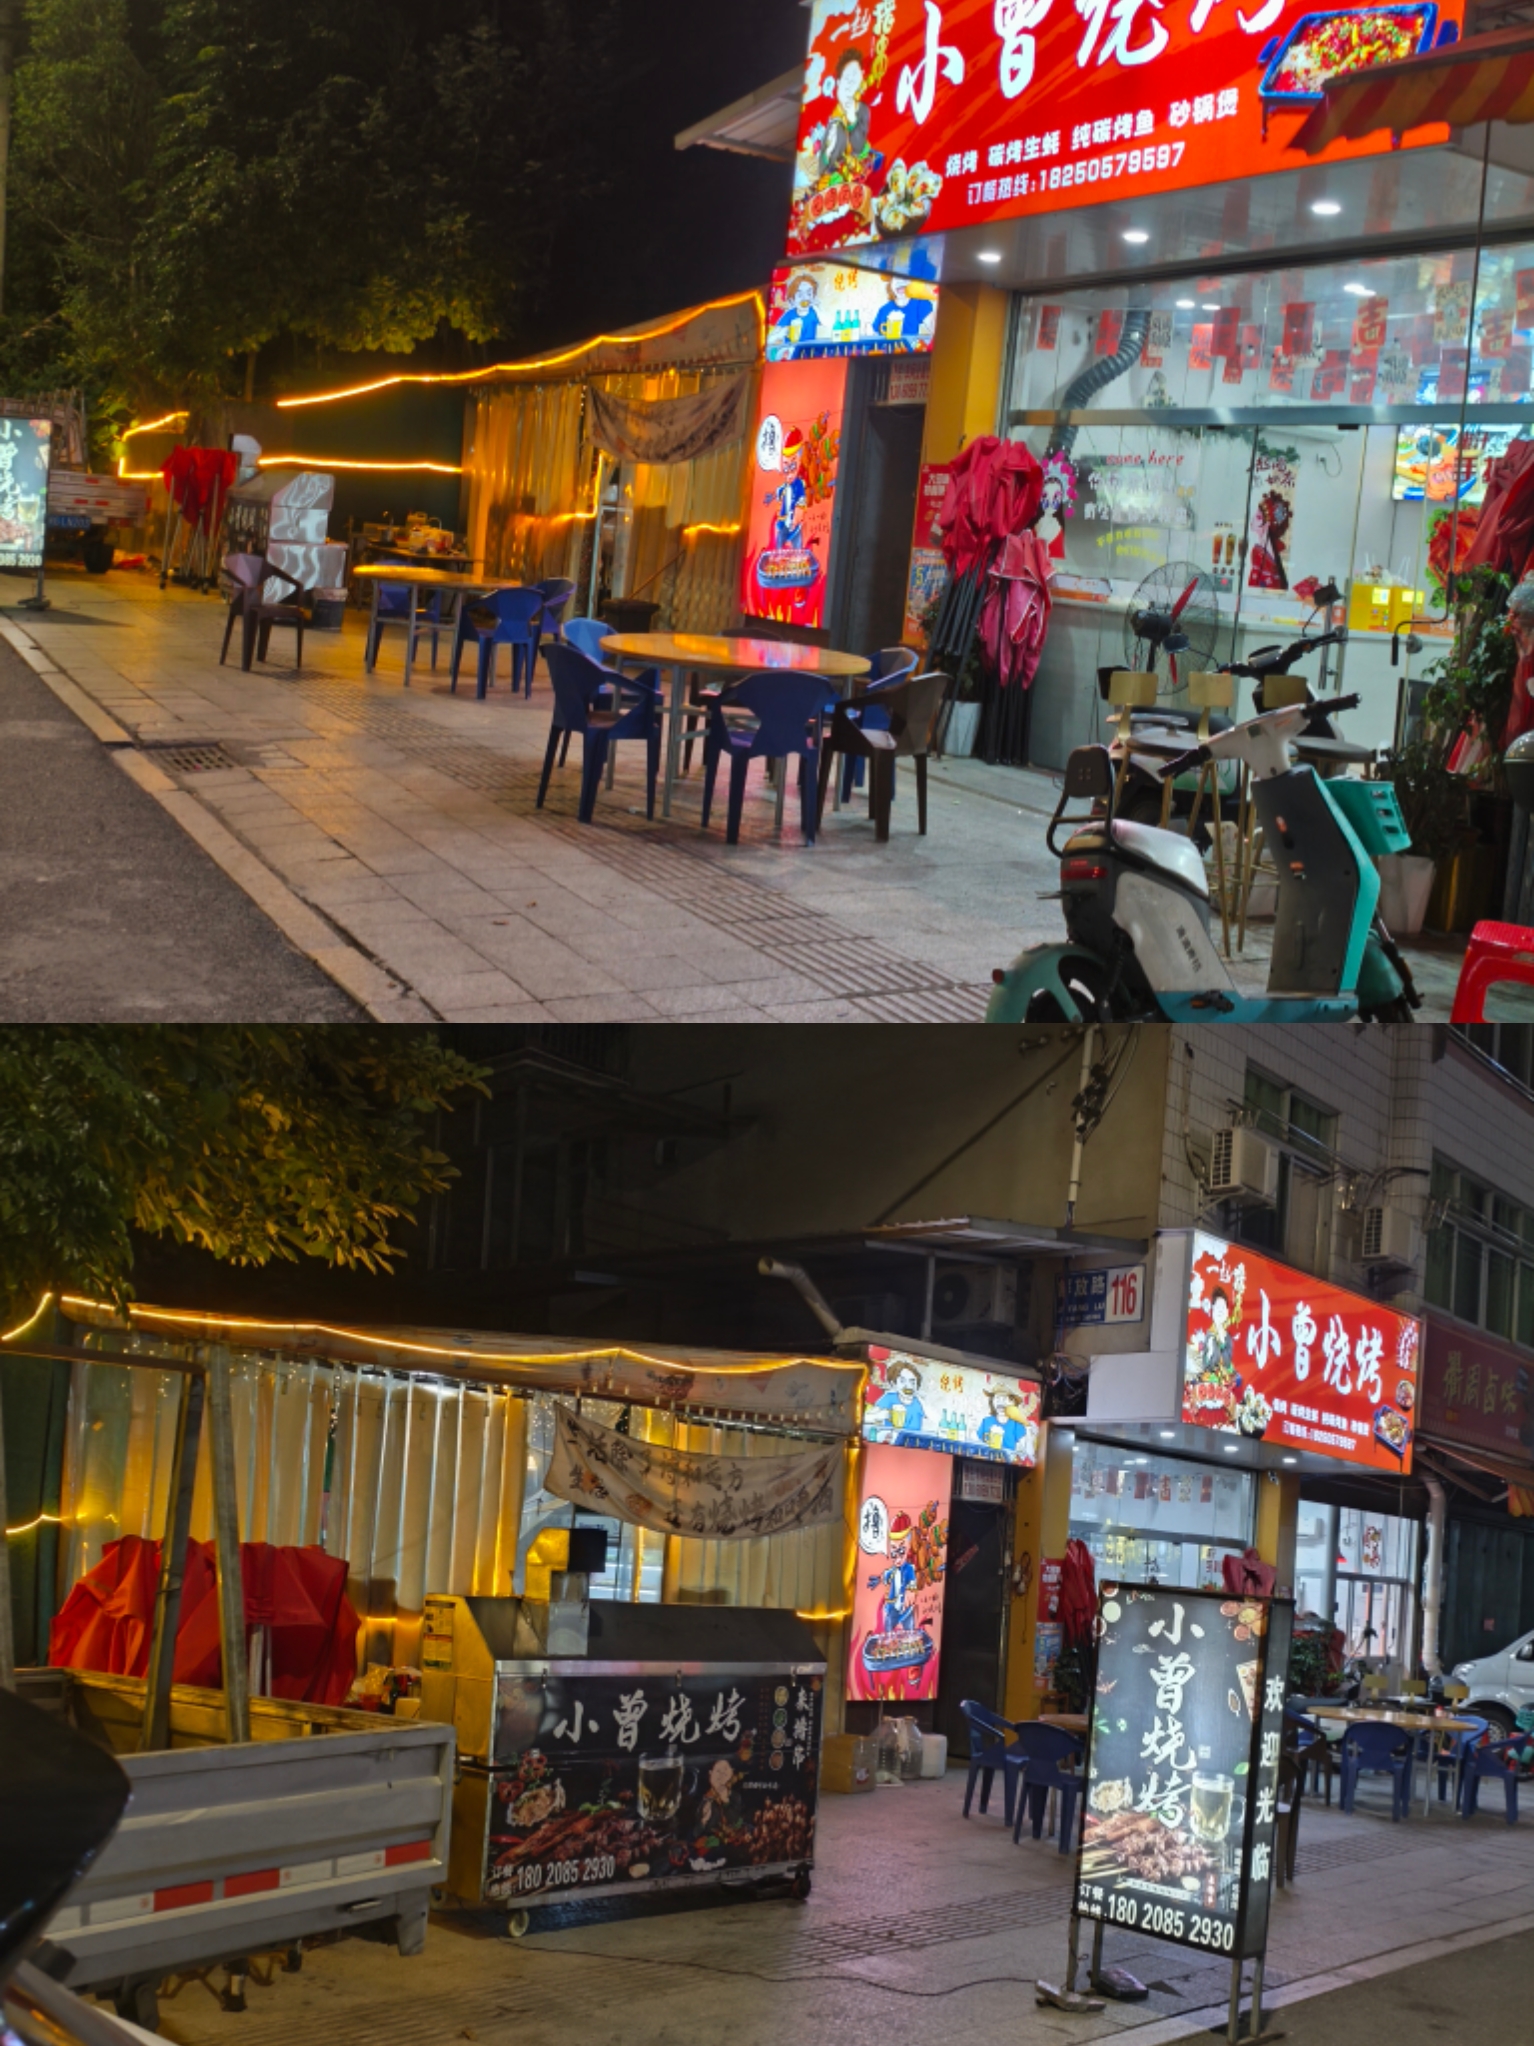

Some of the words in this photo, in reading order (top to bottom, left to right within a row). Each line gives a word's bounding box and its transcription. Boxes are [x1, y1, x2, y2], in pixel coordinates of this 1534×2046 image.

[896, 0, 1284, 125] 小曾烧
[1111, 1272, 1137, 1316] 116
[1246, 1288, 1385, 1404] 小曾烧烤
[553, 1687, 747, 1752] 小曾烧烤
[1133, 1602, 1206, 1831] 小曾烧烤
[1249, 1673, 1285, 1883] 欢迎光临
[517, 1863, 543, 1891] 180
[546, 1859, 580, 1886] 2085
[582, 1855, 616, 1881] 2930
[1108, 1893, 1138, 1926] 180
[1141, 1901, 1186, 1938] 2085
[1187, 1914, 1235, 1951] 2930
